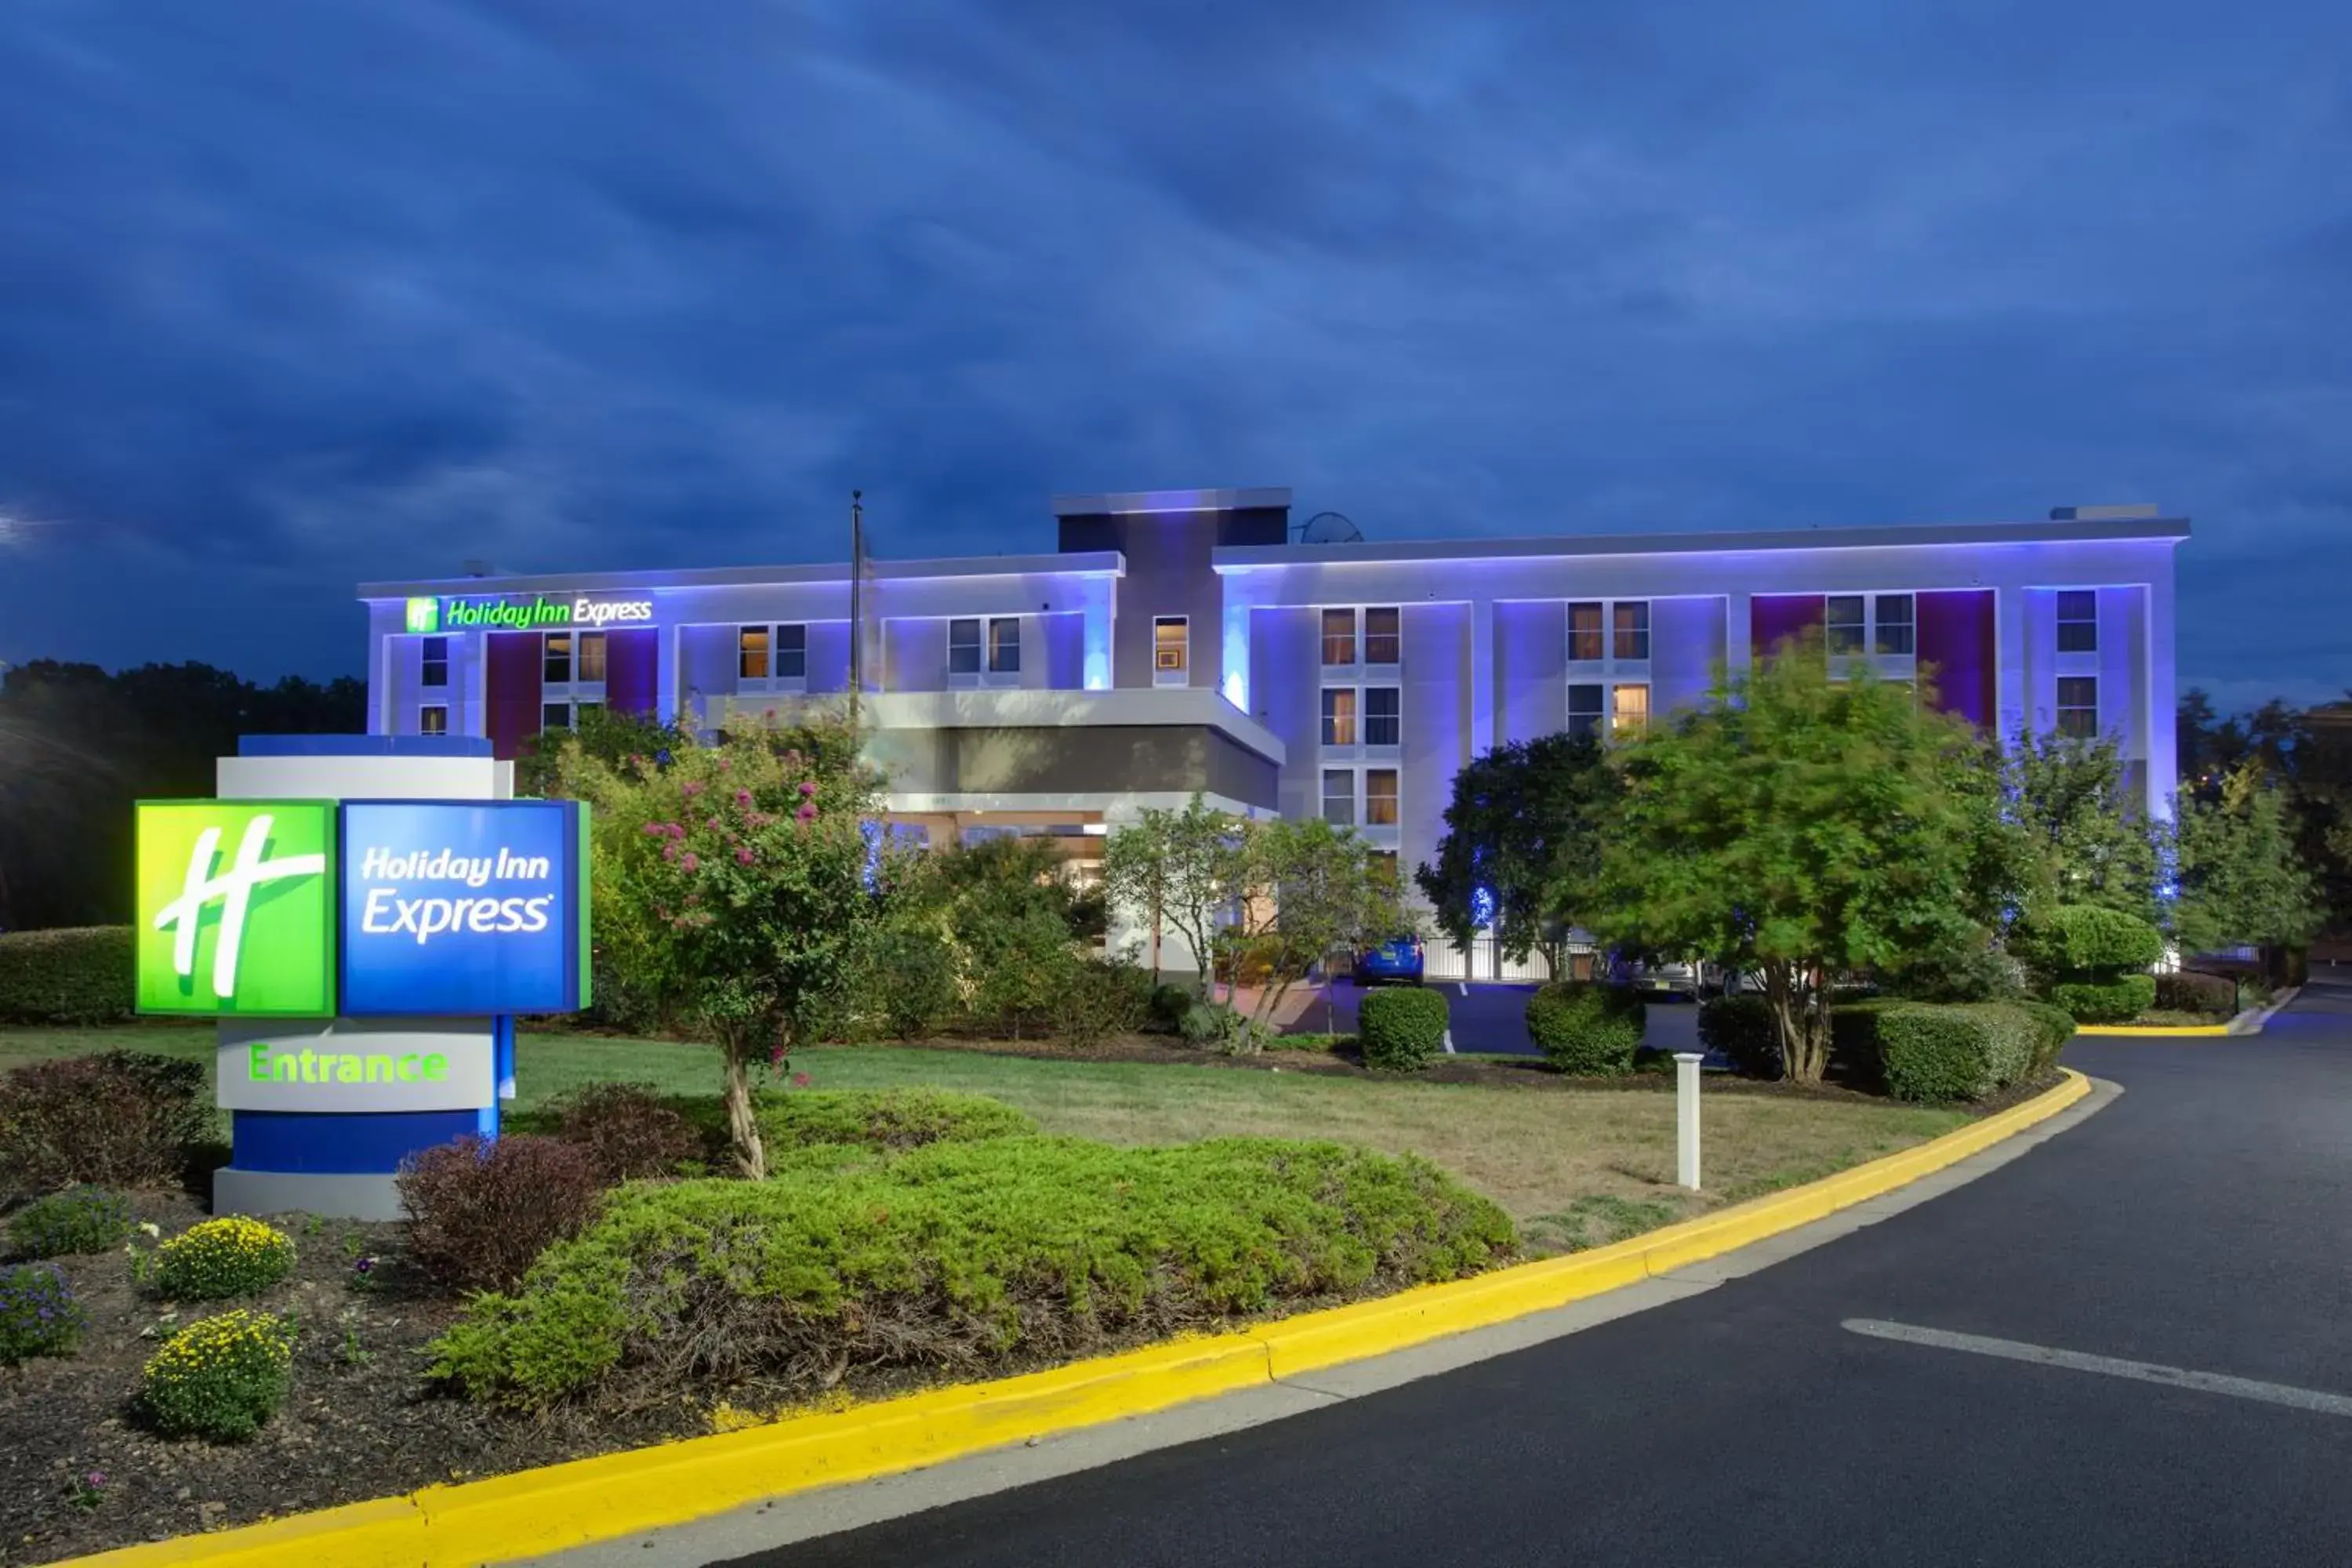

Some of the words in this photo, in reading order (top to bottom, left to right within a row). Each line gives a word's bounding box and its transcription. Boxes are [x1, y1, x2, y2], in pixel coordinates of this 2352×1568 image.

[447, 599, 533, 630] Holiday
[534, 597, 571, 623] Inn
[573, 598, 652, 626] Express
[361, 847, 492, 887] Holiday
[495, 847, 550, 879] Inn
[361, 887, 549, 946] Express
[249, 1043, 450, 1083] Entrance
